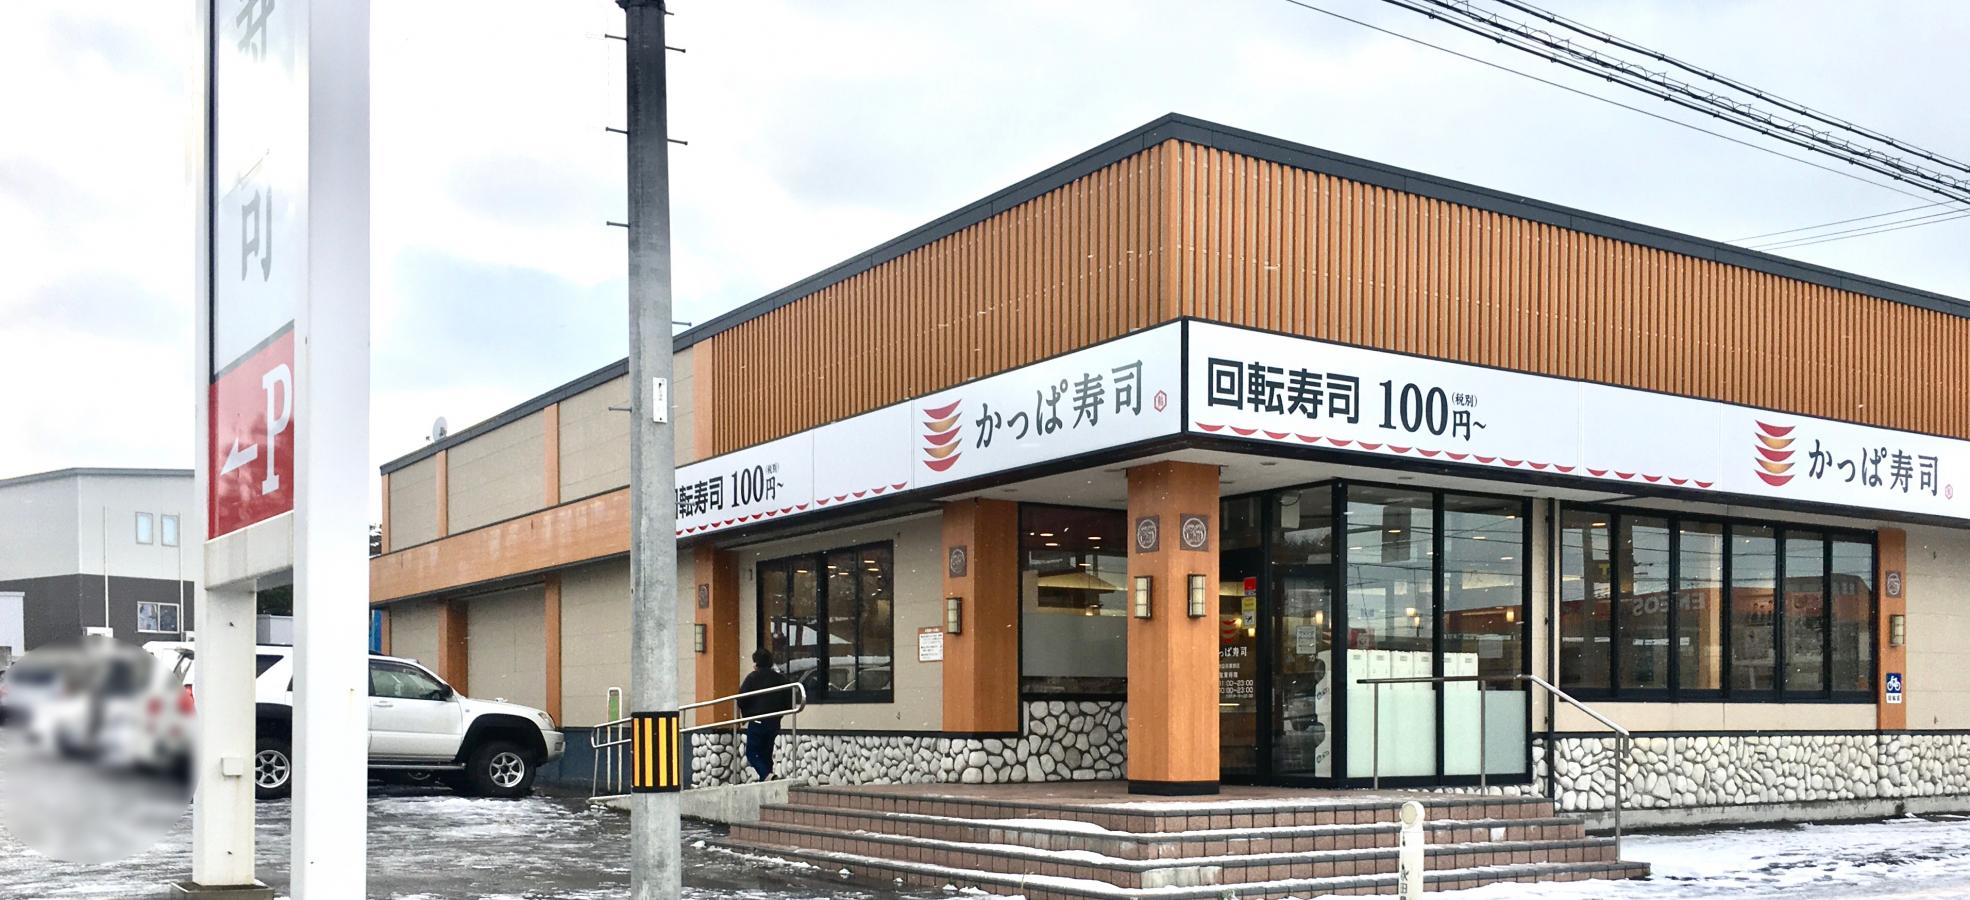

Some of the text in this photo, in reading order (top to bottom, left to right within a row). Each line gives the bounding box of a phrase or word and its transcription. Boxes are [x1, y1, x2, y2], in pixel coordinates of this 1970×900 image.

[975, 359, 1143, 449] かっぱ寿司
[1207, 357, 1360, 424] 回転寿司
[261, 363, 293, 496] P
[675, 476, 724, 519] 転寿司
[1808, 439, 1939, 497] かっぱ寿司
